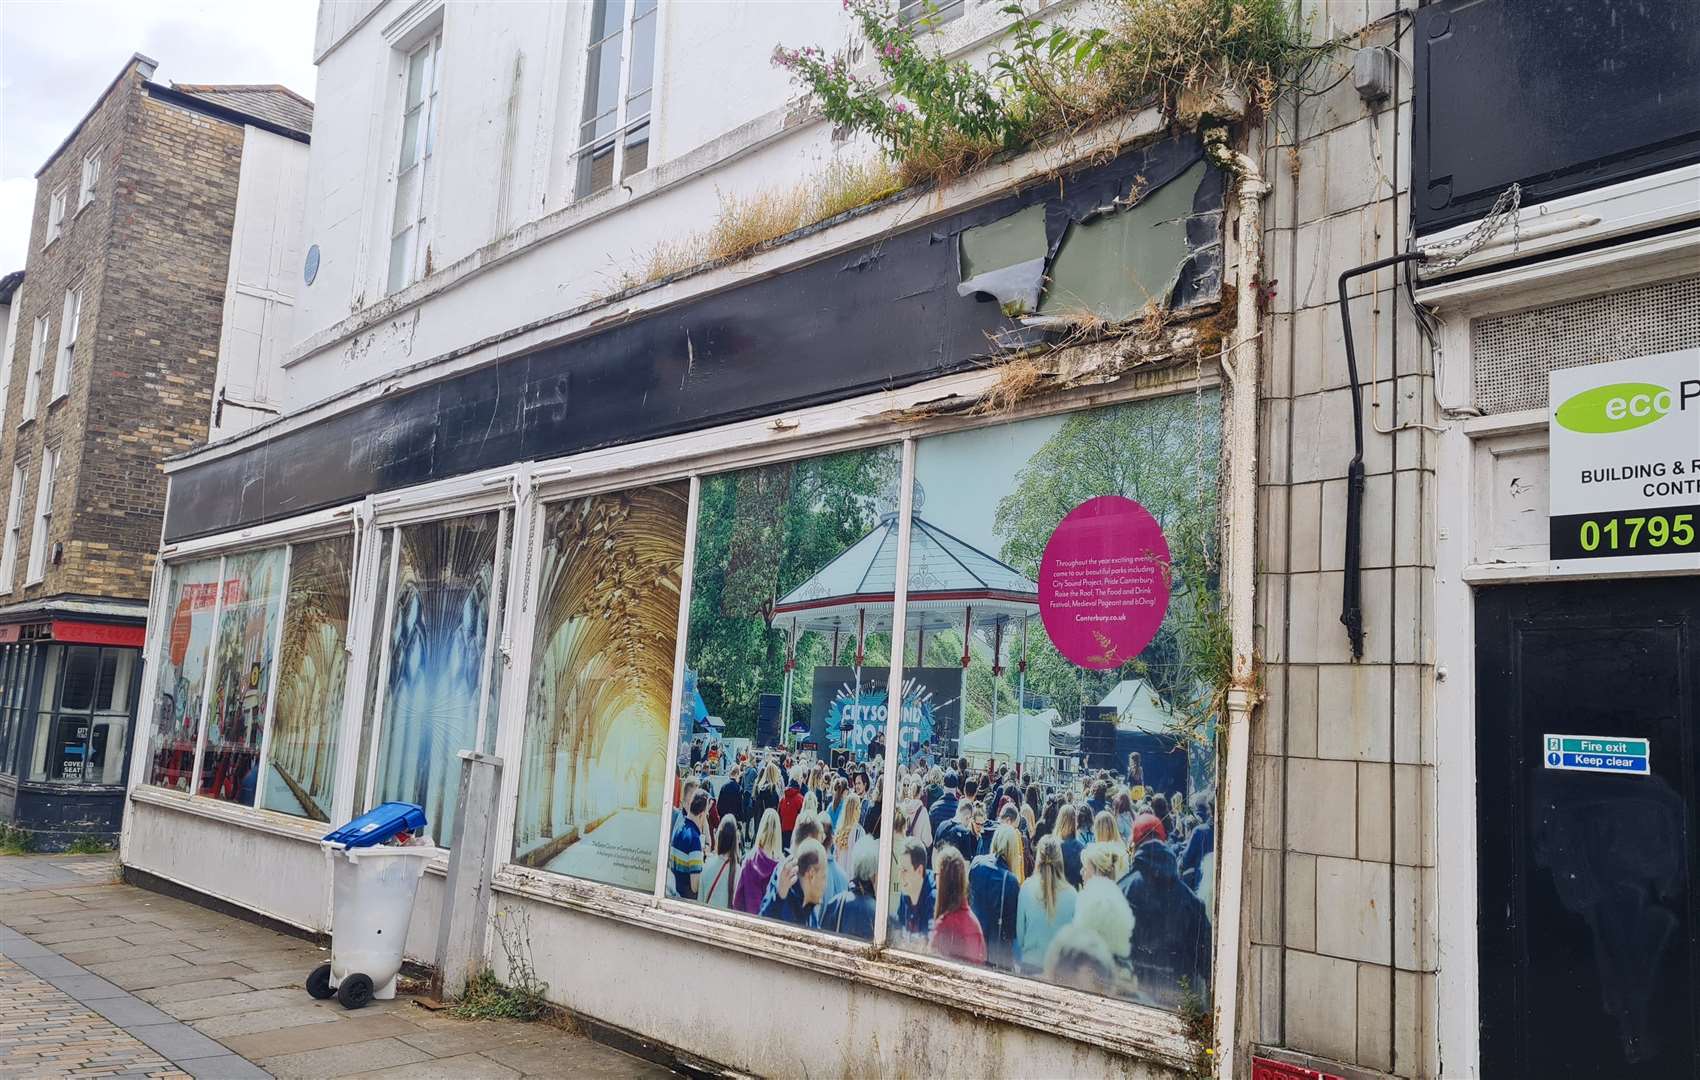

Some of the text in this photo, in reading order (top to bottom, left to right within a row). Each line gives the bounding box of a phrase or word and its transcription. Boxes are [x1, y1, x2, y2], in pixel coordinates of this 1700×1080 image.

[1581, 462, 1666, 484] BUILDING
[1672, 460, 1685, 475] &
[1579, 514, 1695, 552] 01795
[1055, 559, 1088, 568] Throughout
[1088, 557, 1098, 565] the
[1098, 557, 1111, 566] year
[1111, 556, 1134, 565] exciting
[1085, 567, 1111, 576] beautiful
[1111, 566, 1127, 575] parks
[1127, 565, 1155, 574] including
[1052, 580, 1064, 589] City
[1064, 578, 1082, 588] Sound
[1104, 577, 1119, 586] Pride
[1054, 590, 1069, 598] Raise
[1069, 589, 1079, 597] the
[1095, 588, 1106, 596] The
[1106, 587, 1122, 596] Food
[1122, 587, 1135, 595] and
[1072, 599, 1097, 608] Medieval
[1097, 598, 1122, 608] Pageant
[1122, 597, 1135, 606] and
[1075, 613, 1127, 623] Canterbury.co.uk
[1581, 740, 1627, 753] Fire exit
[1574, 754, 1634, 768] Keep clear
